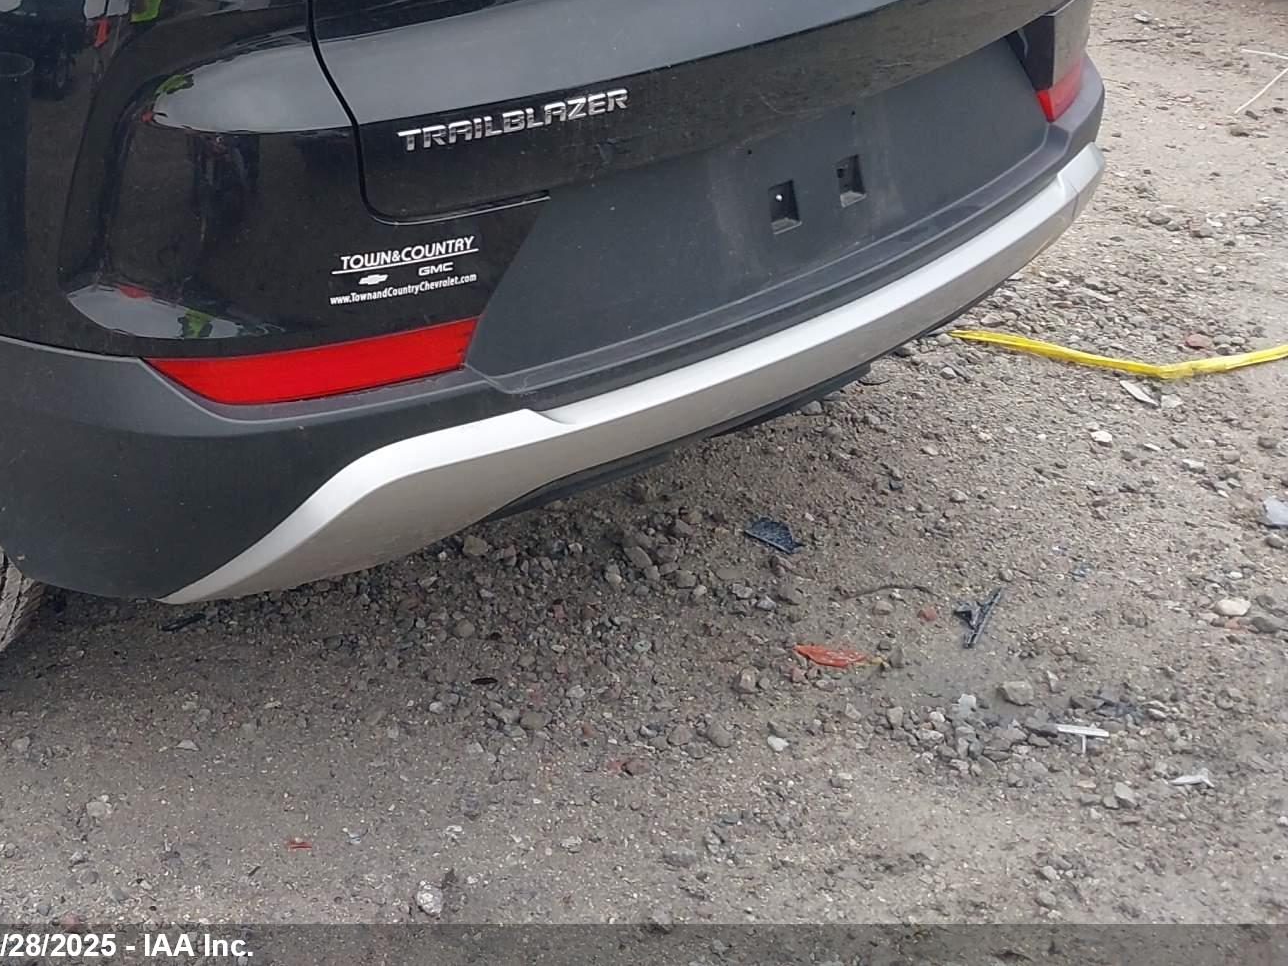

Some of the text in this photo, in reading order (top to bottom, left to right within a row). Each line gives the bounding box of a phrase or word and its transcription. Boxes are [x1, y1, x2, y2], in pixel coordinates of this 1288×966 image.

[397, 88, 629, 151] TRAILBLAZER
[340, 236, 475, 271] TOWN&COUNTRY
[418, 262, 454, 277] GMC
[329, 273, 478, 306] www.TownandCountryChevrolet.com
